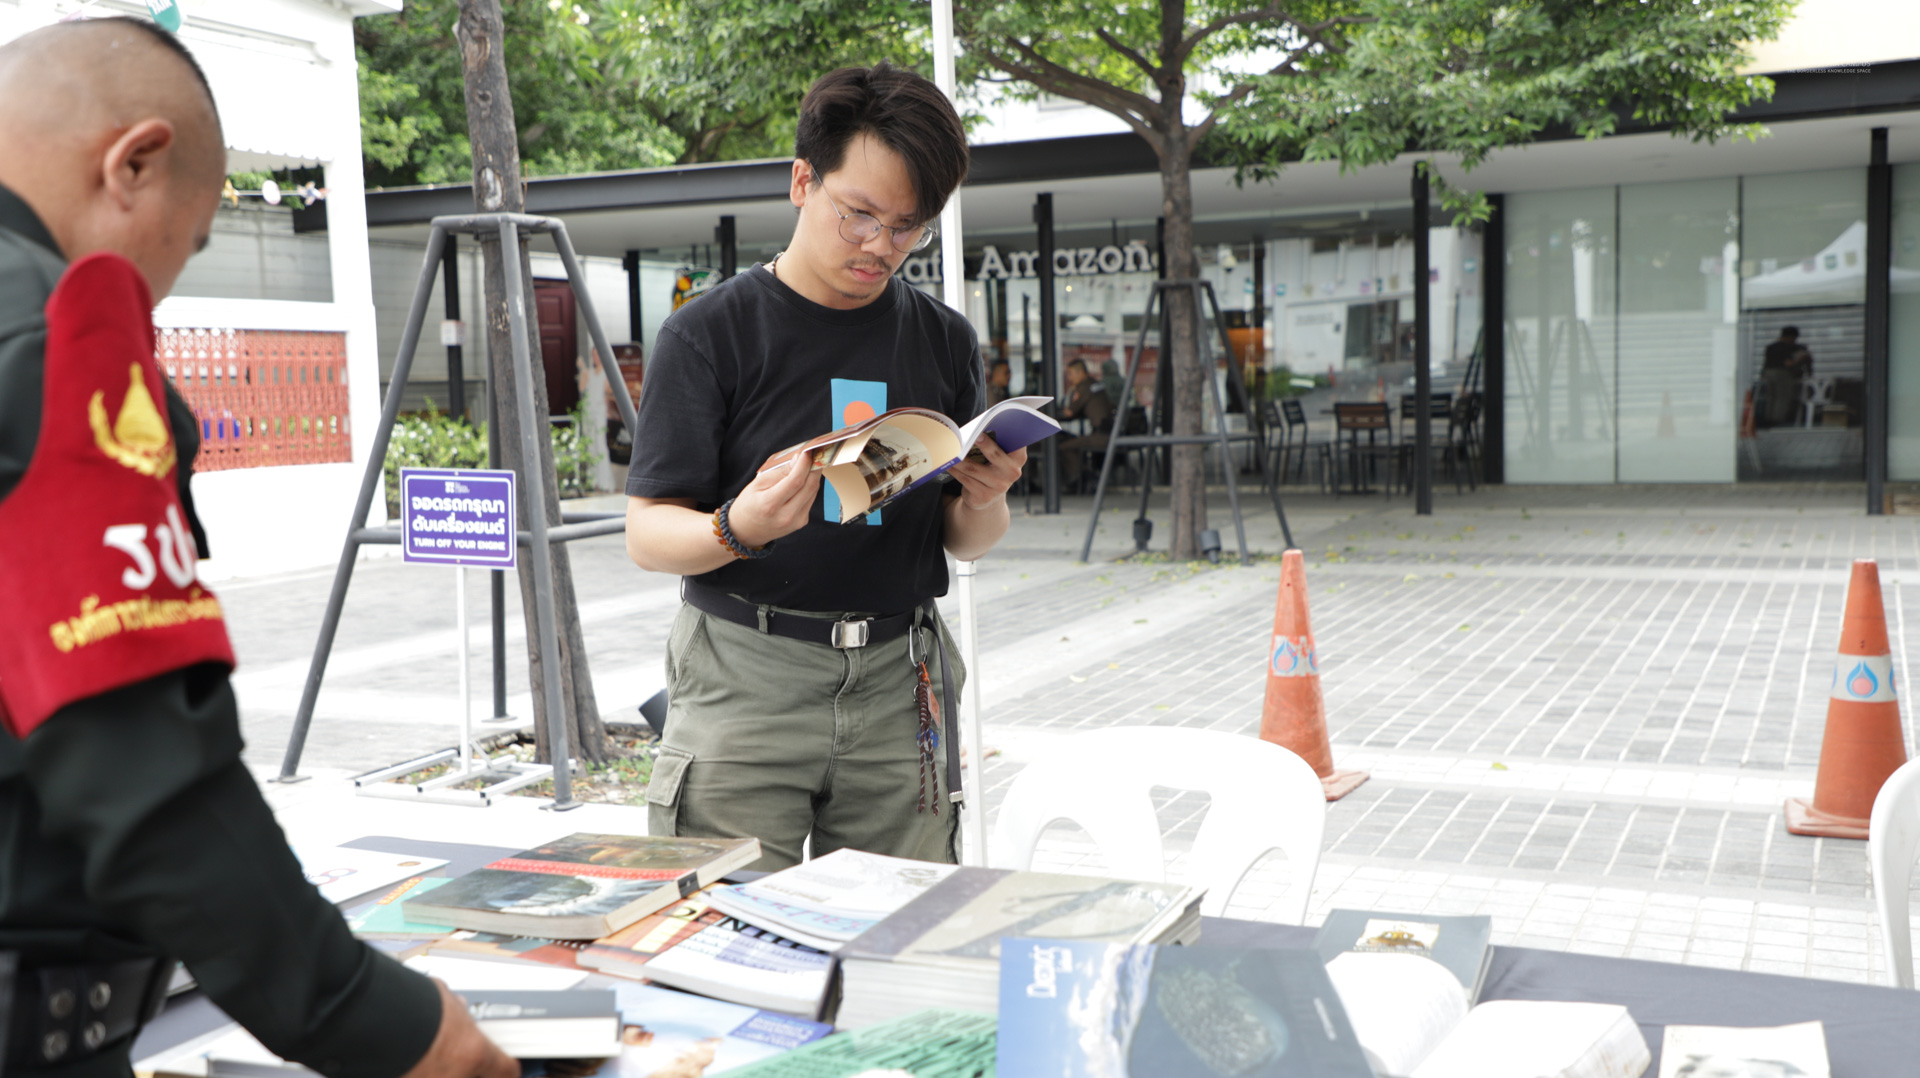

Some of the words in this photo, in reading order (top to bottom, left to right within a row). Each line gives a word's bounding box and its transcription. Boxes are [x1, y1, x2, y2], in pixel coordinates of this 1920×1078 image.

[411, 496, 505, 517] จอดรถกรุณา
[412, 512, 506, 535] ดับเครื่องยนต์
[413, 537, 435, 548] TURN
[436, 538, 452, 548] OFF
[454, 539, 476, 549] YOUR
[477, 540, 506, 551] ENGINE
